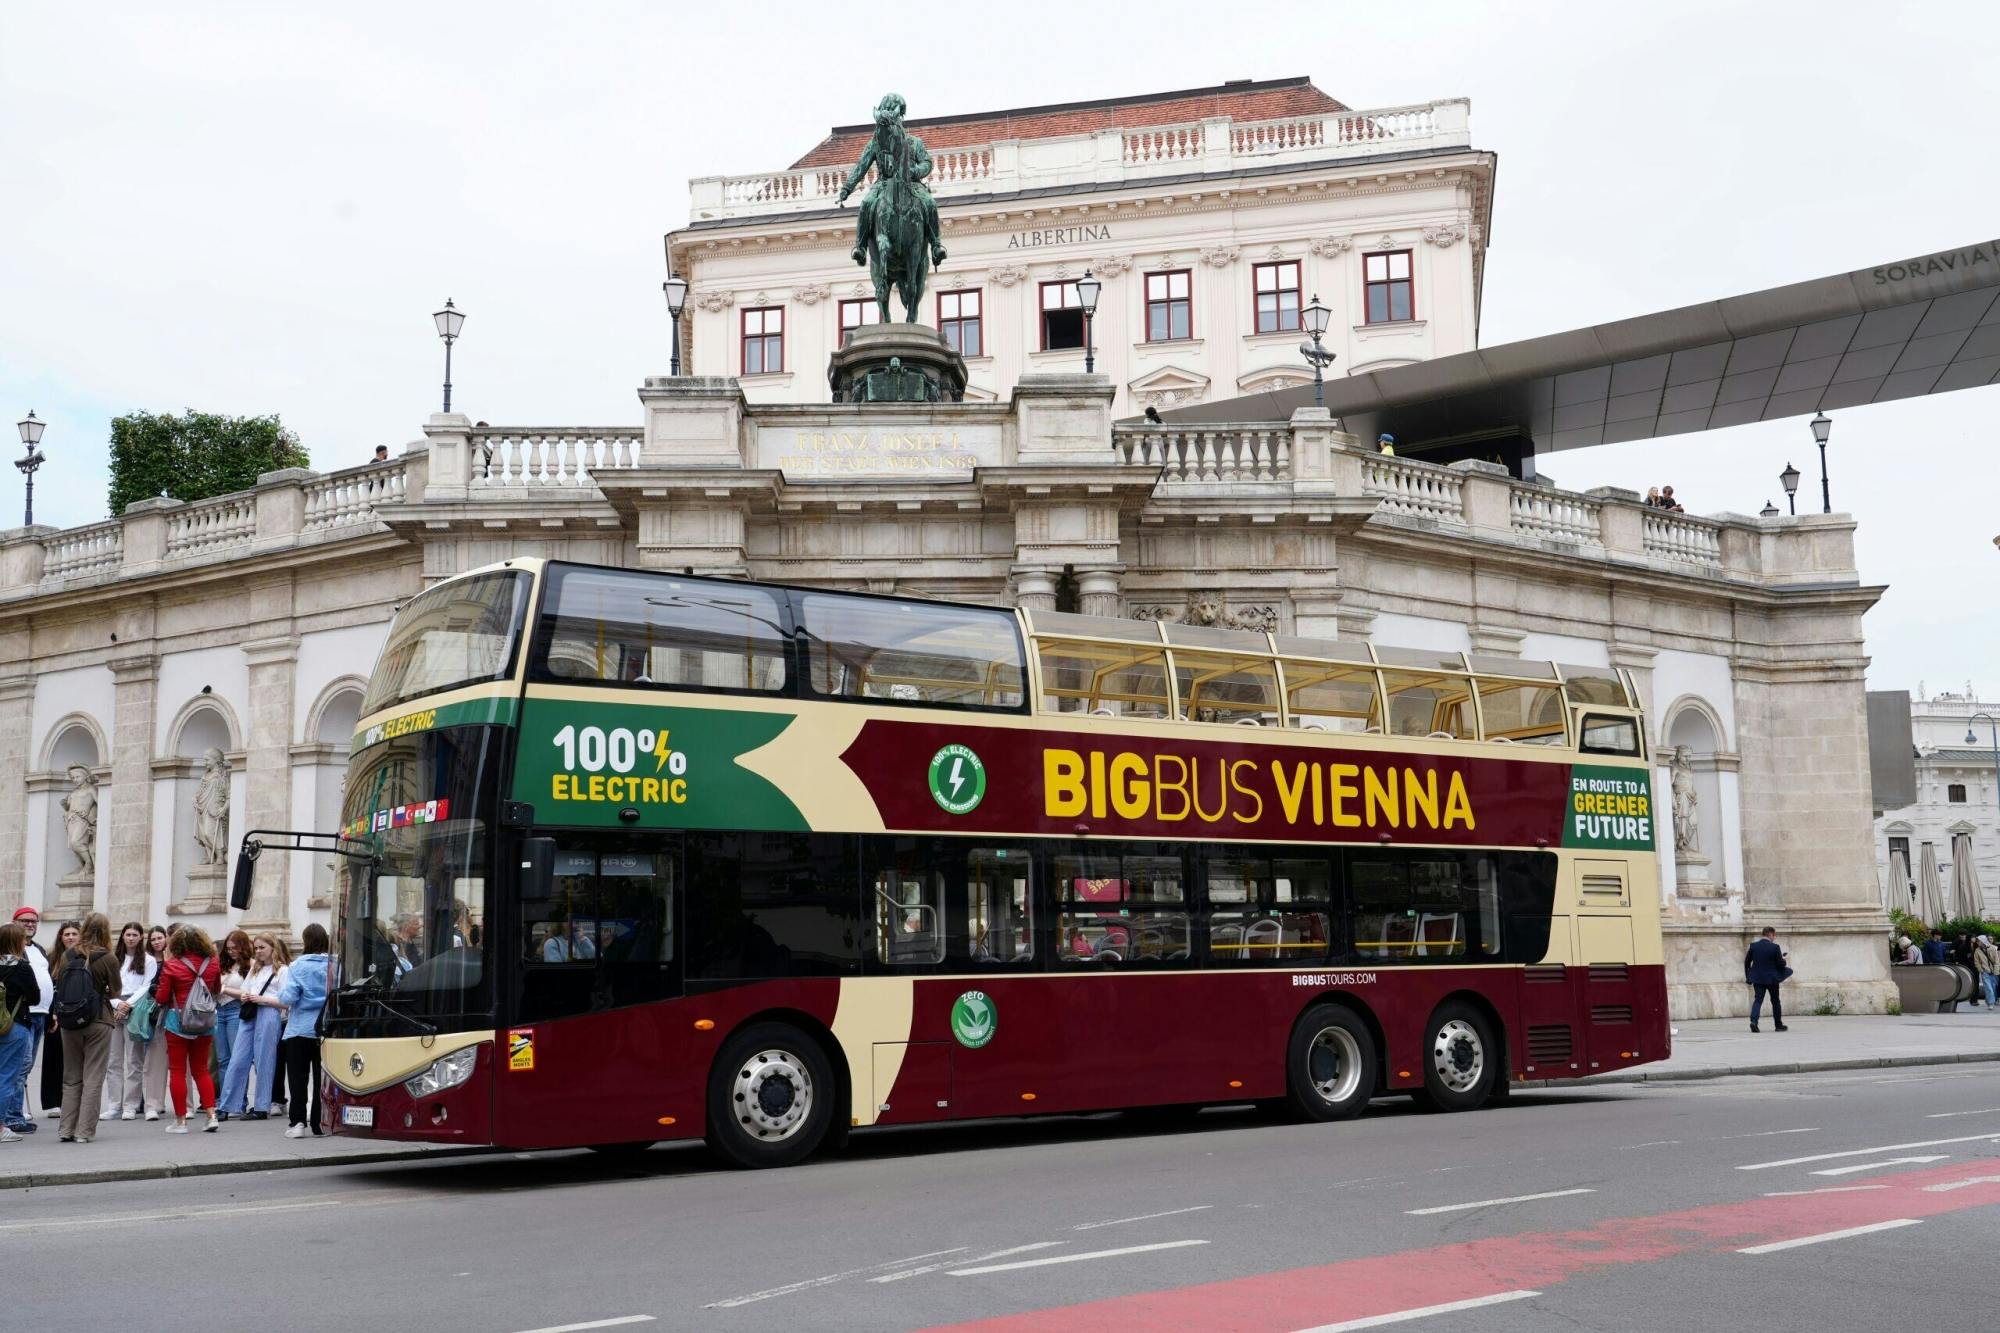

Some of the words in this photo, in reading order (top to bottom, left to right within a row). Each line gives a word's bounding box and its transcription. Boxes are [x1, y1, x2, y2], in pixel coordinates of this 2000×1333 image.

[1008, 224, 1111, 248] ALBERTINA
[1873, 246, 1990, 286] SORAVIA
[797, 431, 869, 451] FRANZ
[887, 455, 931, 469] WIEN
[938, 455, 977, 469] 1869
[365, 723, 385, 746] 100%
[384, 709, 437, 740] ELECTRIC
[552, 724, 687, 775] 100%
[931, 748, 950, 766] 100%
[949, 745, 983, 770] ELECTRIC
[552, 774, 687, 804] ELECTRIC
[1271, 760, 1476, 830] VIENNA
[1572, 777, 1587, 792] EN
[1589, 778, 1623, 794] ROUTE
[1624, 780, 1638, 795] TO
[1639, 782, 1647, 795] A
[1574, 792, 1649, 816] GREENER
[1575, 814, 1650, 841] FUTURE
[1292, 973, 1377, 986] BIGBUSTOURS.COM
[961, 991, 984, 1003] zero
